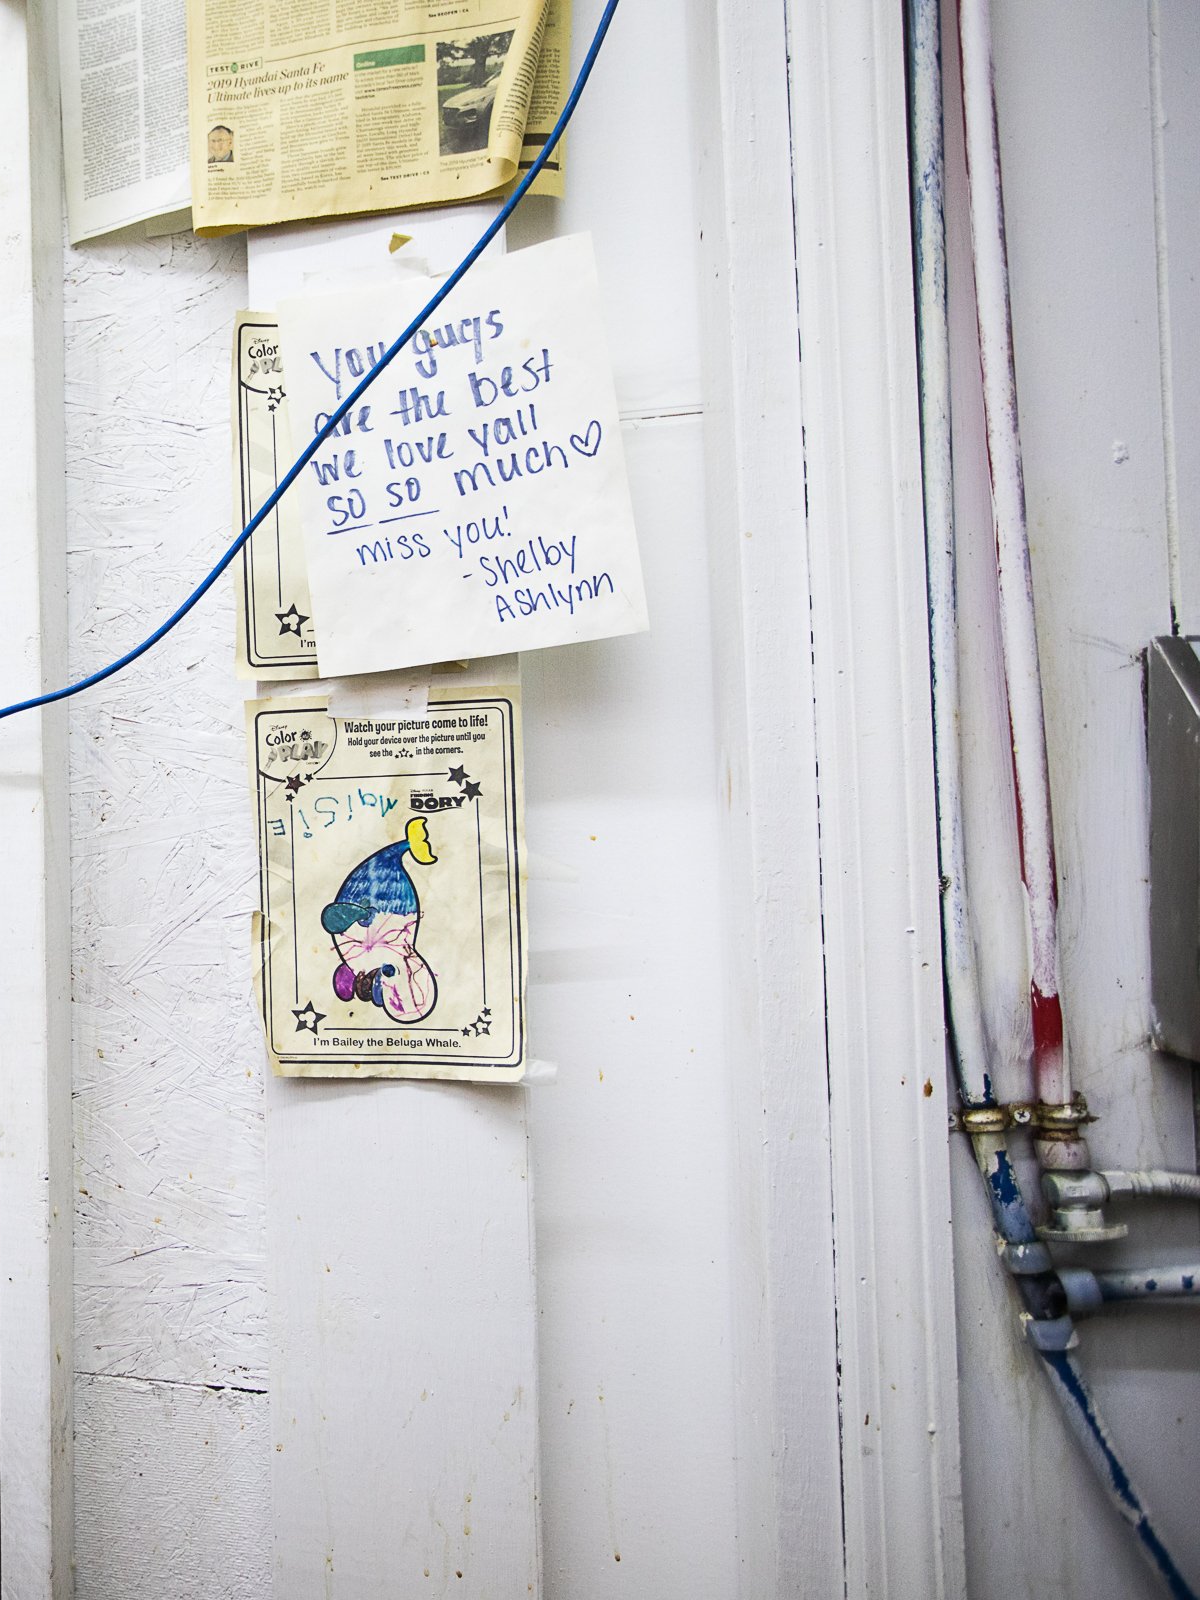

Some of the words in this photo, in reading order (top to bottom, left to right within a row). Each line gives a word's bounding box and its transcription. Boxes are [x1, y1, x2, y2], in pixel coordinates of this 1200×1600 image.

[207, 79, 232, 91] 2019
[234, 71, 278, 90] Hyundai
[279, 66, 310, 81] Santa
[312, 62, 326, 74] Fe
[209, 65, 229, 73] TEST
[207, 90, 253, 104] Ultimate
[253, 86, 276, 98] lives
[278, 83, 291, 95] up
[293, 80, 304, 90] to
[305, 78, 318, 89] its
[319, 72, 350, 86] name
[248, 343, 279, 359] Color
[310, 340, 393, 400] You
[412, 310, 505, 379] guys
[260, 356, 284, 375] PL
[313, 405, 375, 439] are
[391, 387, 451, 428] the
[468, 349, 554, 408] best
[310, 450, 362, 487] we
[384, 432, 454, 471] love
[454, 441, 569, 498] much
[356, 535, 431, 567] miss
[443, 505, 512, 558] you!
[344, 720, 374, 734] Watch
[375, 721, 395, 735] your
[397, 720, 430, 734] picture
[432, 718, 457, 729] come
[458, 717, 468, 728] to
[469, 714, 488, 727] life!
[265, 730, 298, 747] Color
[347, 737, 363, 746] Hold
[363, 738, 379, 748] your
[380, 736, 402, 745] device
[403, 736, 417, 744] over
[418, 734, 430, 743] the
[430, 733, 455, 744] picture
[456, 732, 472, 741] until
[472, 733, 486, 742] you
[277, 740, 328, 763] PLAY
[382, 748, 393, 757] the
[415, 747, 423, 755] in
[423, 747, 434, 755] the
[435, 746, 464, 755] corners.
[410, 796, 467, 810] DORY
[313, 1037, 330, 1047] I'm
[332, 1037, 364, 1049] Bailey
[367, 1037, 384, 1047] the
[386, 1037, 423, 1049] Beluga
[425, 1038, 461, 1048] Whale.
